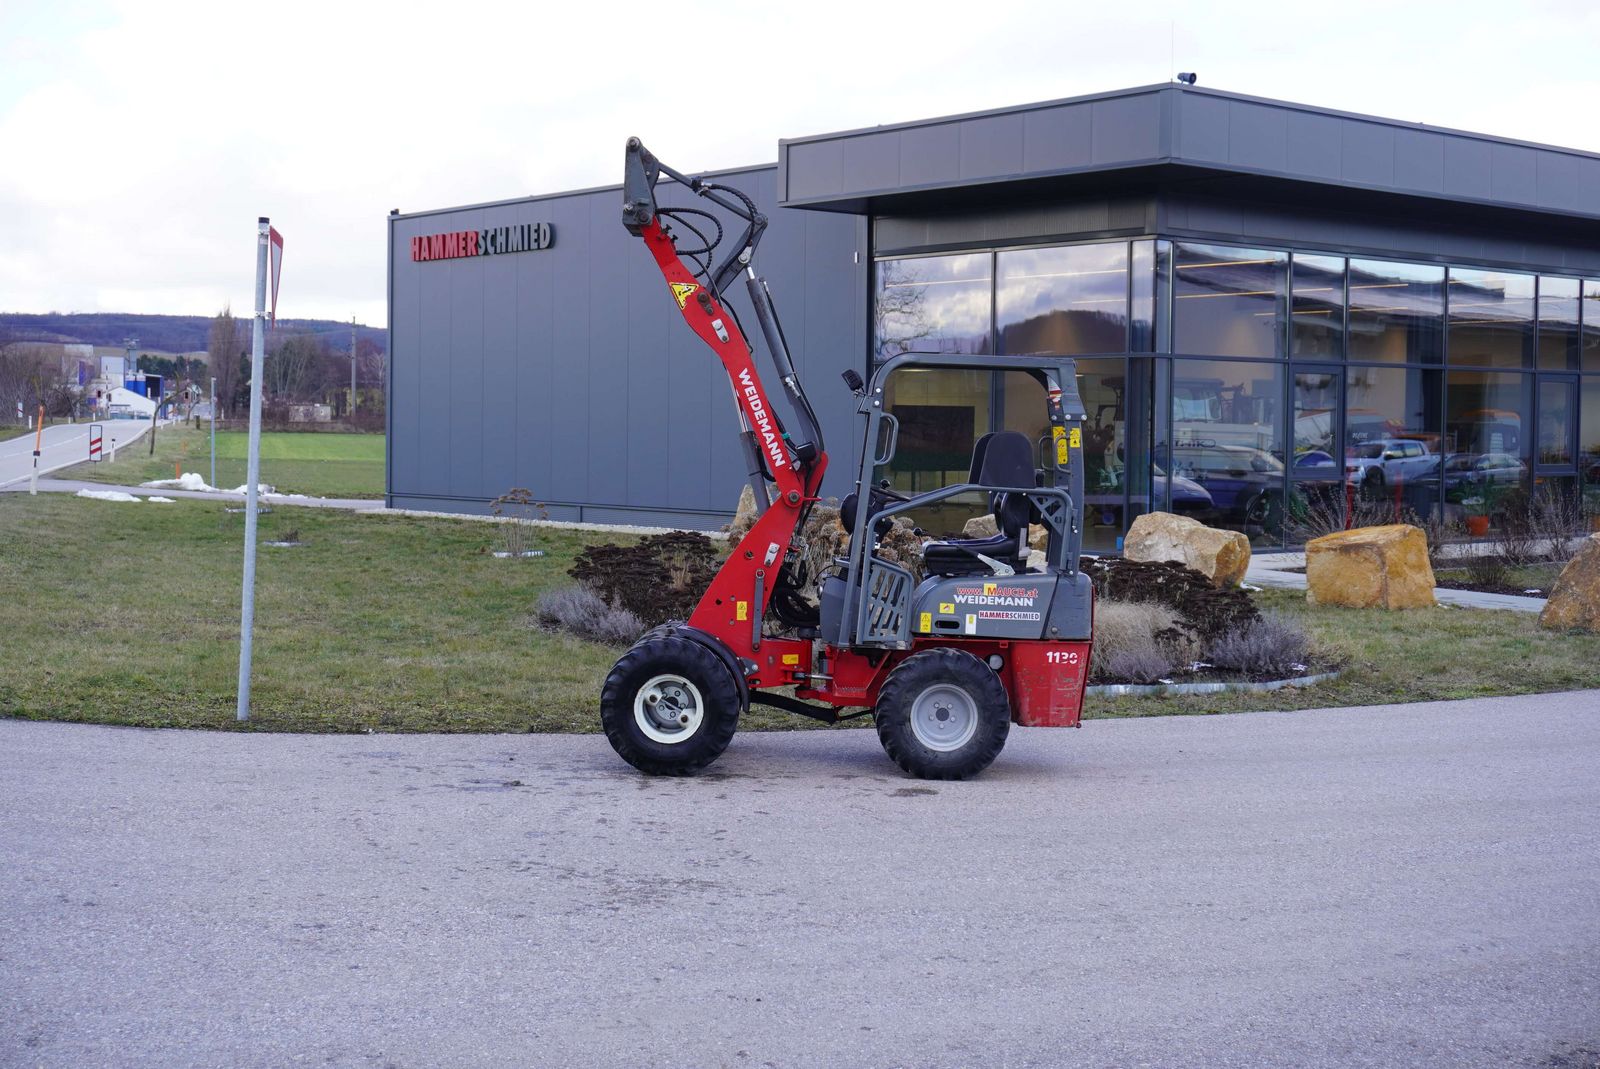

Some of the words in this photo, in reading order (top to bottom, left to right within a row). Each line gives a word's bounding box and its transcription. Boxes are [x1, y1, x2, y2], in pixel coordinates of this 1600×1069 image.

[410, 222, 555, 262] HAMMERSCHMIED
[739, 368, 785, 467] WEIDEMANN
[953, 594, 1033, 607] WEIDEMANN
[979, 611, 1040, 620] HAMMERSCHMIED
